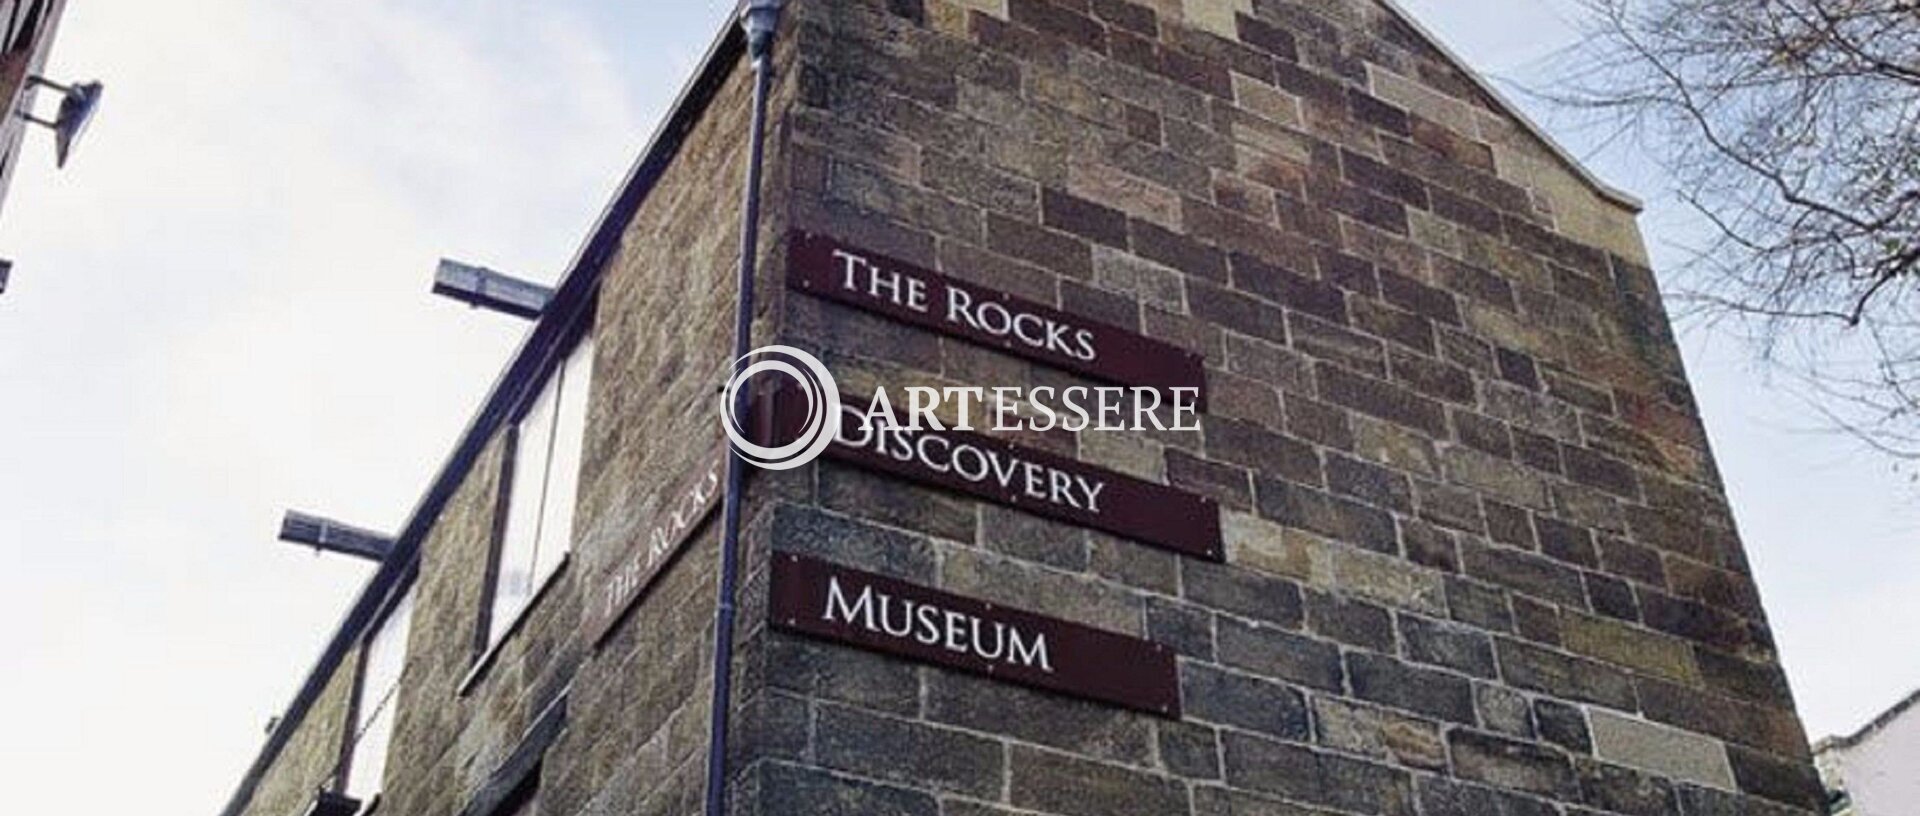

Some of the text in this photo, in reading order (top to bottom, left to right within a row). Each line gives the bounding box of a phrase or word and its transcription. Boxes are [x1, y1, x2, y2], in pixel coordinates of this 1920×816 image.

[833, 250, 1096, 361] THE ROCKS
[833, 404, 1102, 512] DISCOVERY
[823, 576, 1053, 672] MUSEUM
